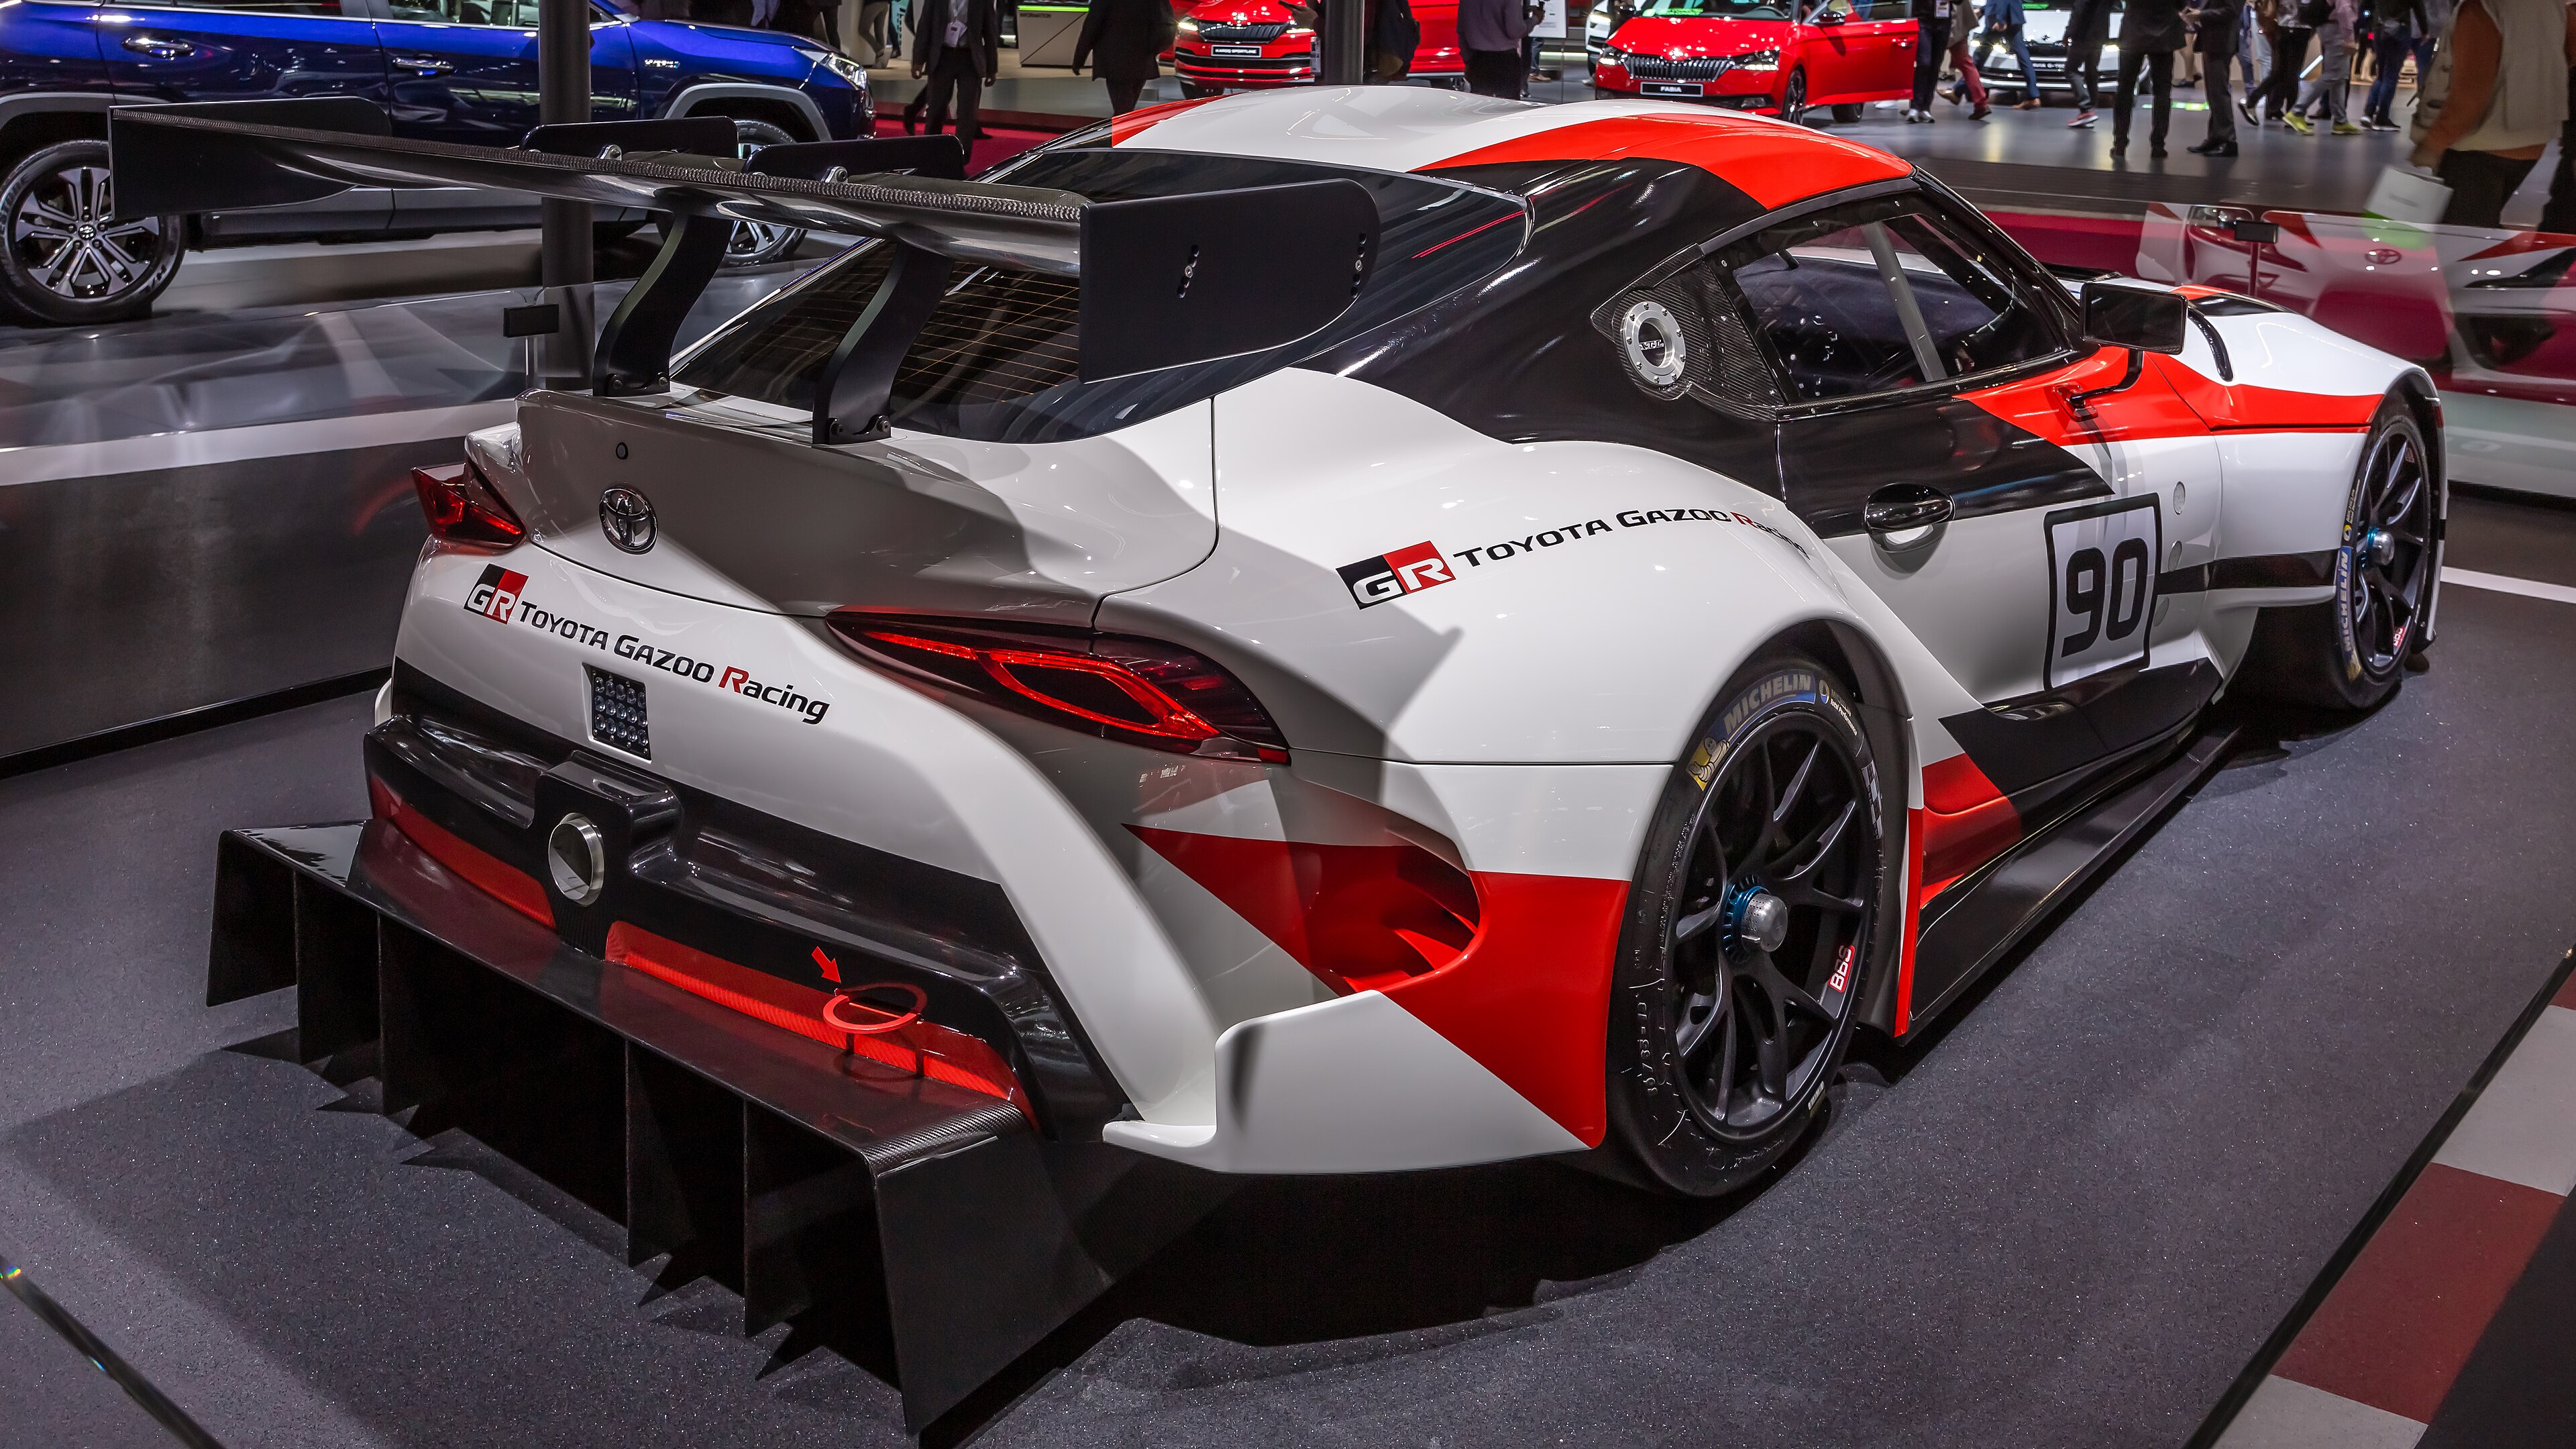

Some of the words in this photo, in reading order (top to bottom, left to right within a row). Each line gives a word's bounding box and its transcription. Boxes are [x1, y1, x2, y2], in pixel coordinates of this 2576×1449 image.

[1347, 553, 1454, 607] GR
[1453, 519, 1613, 568] TOYOTA
[1615, 507, 1732, 529] GAZOO
[1729, 512, 1811, 560] Racing
[2061, 537, 2149, 658] 90
[2340, 550, 2352, 651] MICHELIN
[464, 580, 518, 624] GR
[520, 600, 608, 651] TOYOTA
[614, 634, 716, 684] GAZOO
[718, 665, 830, 726] Racing
[1723, 673, 1811, 735] MICHELIN
